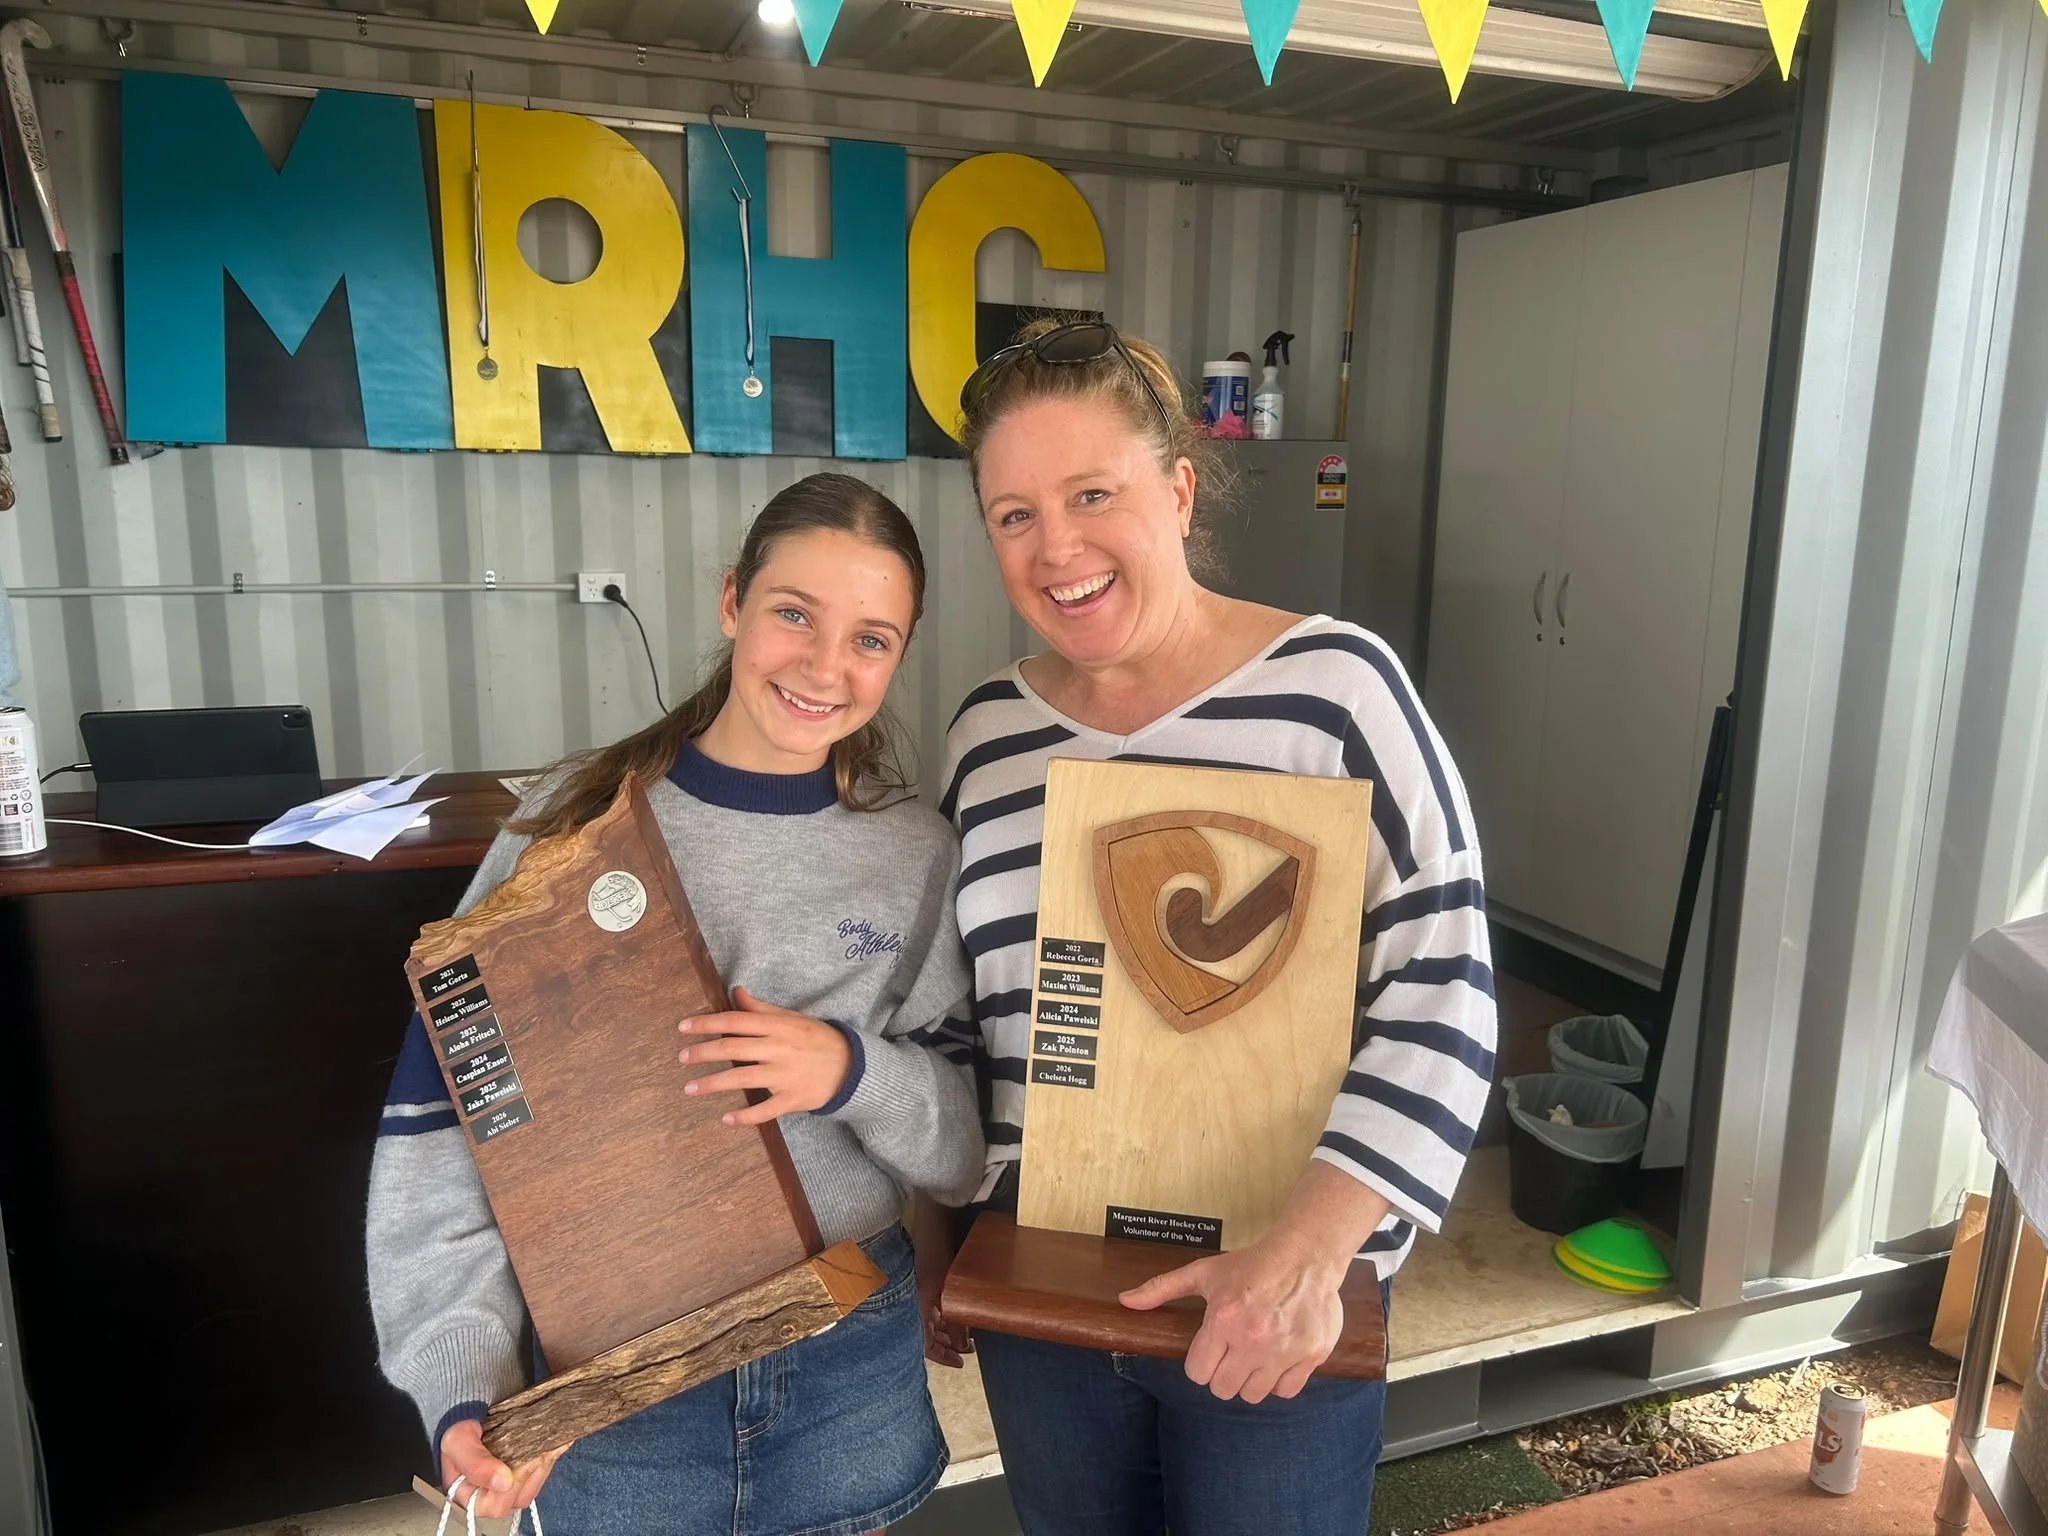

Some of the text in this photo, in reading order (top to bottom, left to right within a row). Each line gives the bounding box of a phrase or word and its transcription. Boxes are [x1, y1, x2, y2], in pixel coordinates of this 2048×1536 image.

[837, 918, 873, 940] Body
[1065, 944, 1081, 952] 2022
[1046, 951, 1099, 964] Rebecca Gorta
[431, 972, 469, 993] Tom Gorta
[1062, 973, 1081, 982] 2023
[1041, 980, 1100, 994] Maxine Williams
[450, 997, 467, 1009] 2022
[1060, 1004, 1079, 1014] 2024
[434, 998, 488, 1027] Helena Williams
[1039, 1012, 1098, 1025] Alicia Pawelski
[460, 1025, 478, 1039] 2023
[469, 1027, 496, 1044] Fritsch
[1056, 1035, 1076, 1044] 2025
[1041, 1043, 1089, 1055] Zak Pointon
[470, 1053, 488, 1067] 2024
[456, 1055, 508, 1084] Caspian Ensor
[1056, 1064, 1072, 1073] 2026
[1039, 1072, 1088, 1085] Chelsea Hogg
[479, 1081, 497, 1095] 2025
[466, 1082, 517, 1112] Jake Pawelski
[491, 1111, 507, 1124] 2026
[486, 1116, 520, 1138] Abi Sieber
[1112, 1212, 1216, 1232] Margaret River Hockey Club
[1123, 1226, 1203, 1243] Volunteer of the Year
